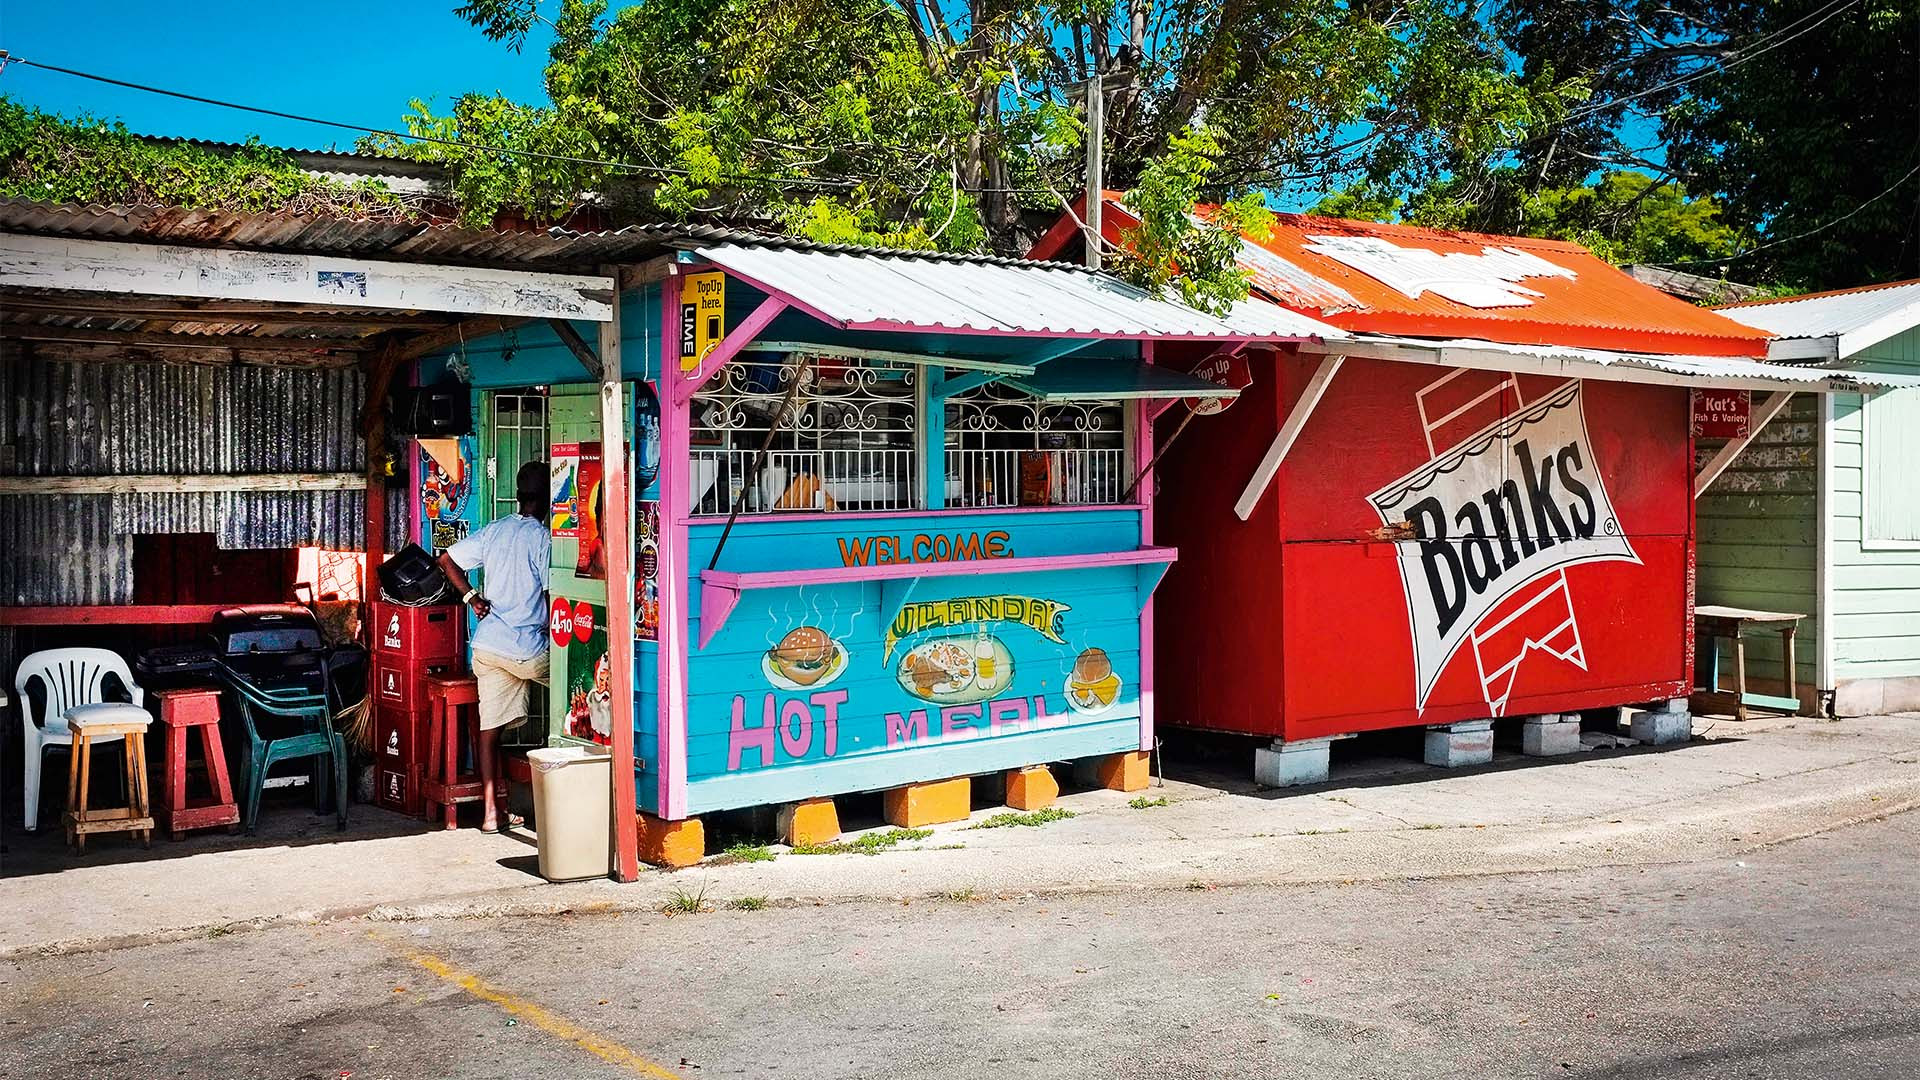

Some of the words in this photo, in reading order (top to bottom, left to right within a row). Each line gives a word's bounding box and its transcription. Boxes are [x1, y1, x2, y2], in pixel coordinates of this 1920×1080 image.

[697, 279, 722, 295] TopUp
[701, 296, 722, 309] here.
[683, 306, 695, 354] LIME
[1195, 366, 1214, 381] Top
[1215, 359, 1230, 375] Up
[1705, 397, 1736, 412] Kat's
[1694, 413, 1708, 422] Fish
[1712, 413, 1718, 422] &
[1722, 413, 1747, 425] Variety
[837, 530, 1014, 567] WELCOME
[1404, 438, 1597, 641] Banks
[551, 609, 560, 633] 4
[384, 635, 401, 649] Banks
[727, 689, 850, 771] HOT
[885, 694, 1068, 751] MEAL
